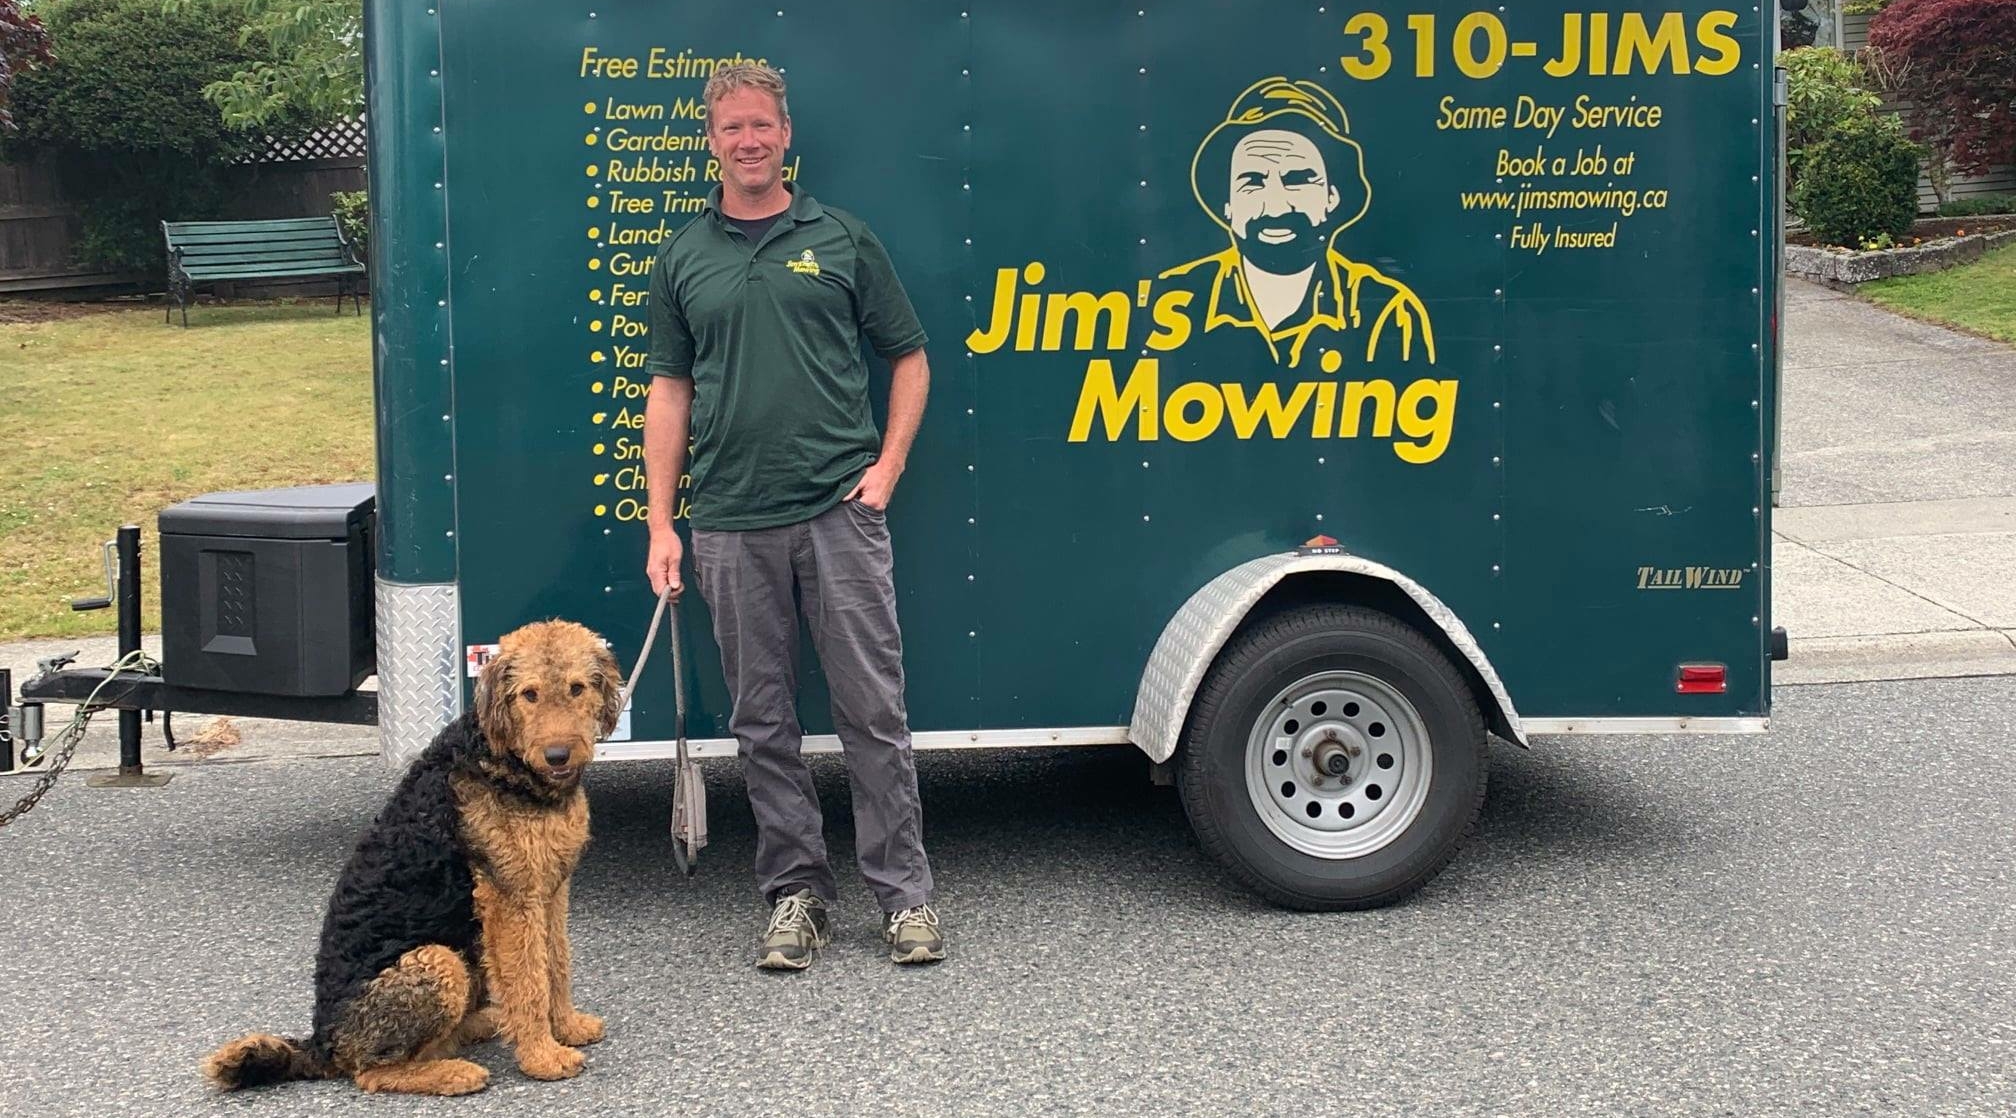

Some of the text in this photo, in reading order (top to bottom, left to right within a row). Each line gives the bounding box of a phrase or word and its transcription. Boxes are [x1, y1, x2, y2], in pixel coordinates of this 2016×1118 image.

[1339, 10, 1742, 81] 310-JIMS
[580, 47, 638, 79] Free
[605, 97, 663, 120] Lawn
[1436, 94, 1663, 139] Same Day Service
[607, 156, 696, 183] Rubbish
[1496, 144, 1635, 176] Book a Job at
[609, 190, 654, 213] Tree
[1460, 182, 1668, 218] www.jimsmowing.ca
[1510, 221, 1618, 256] Fully Insured
[610, 283, 650, 306] Fer
[965, 261, 1194, 354] Jim's
[1067, 349, 1459, 465] Mowing
